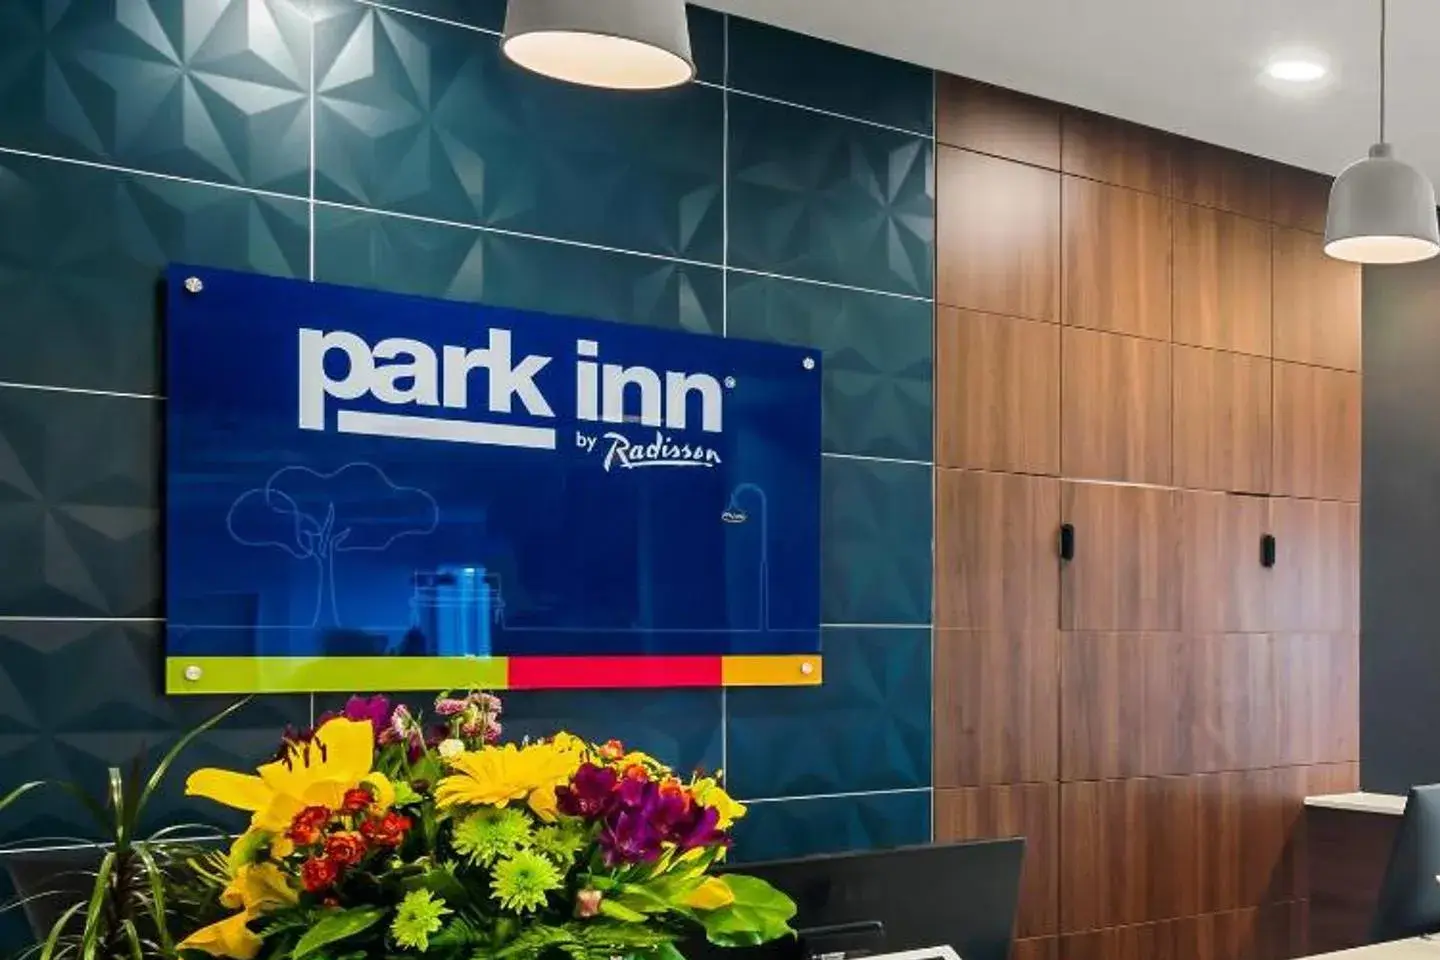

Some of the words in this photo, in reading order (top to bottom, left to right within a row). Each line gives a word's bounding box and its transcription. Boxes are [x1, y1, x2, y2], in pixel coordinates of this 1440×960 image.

[298, 328, 556, 431] park
[576, 339, 723, 433] inn
[576, 431, 597, 452] by
[603, 430, 722, 472] Radisson
